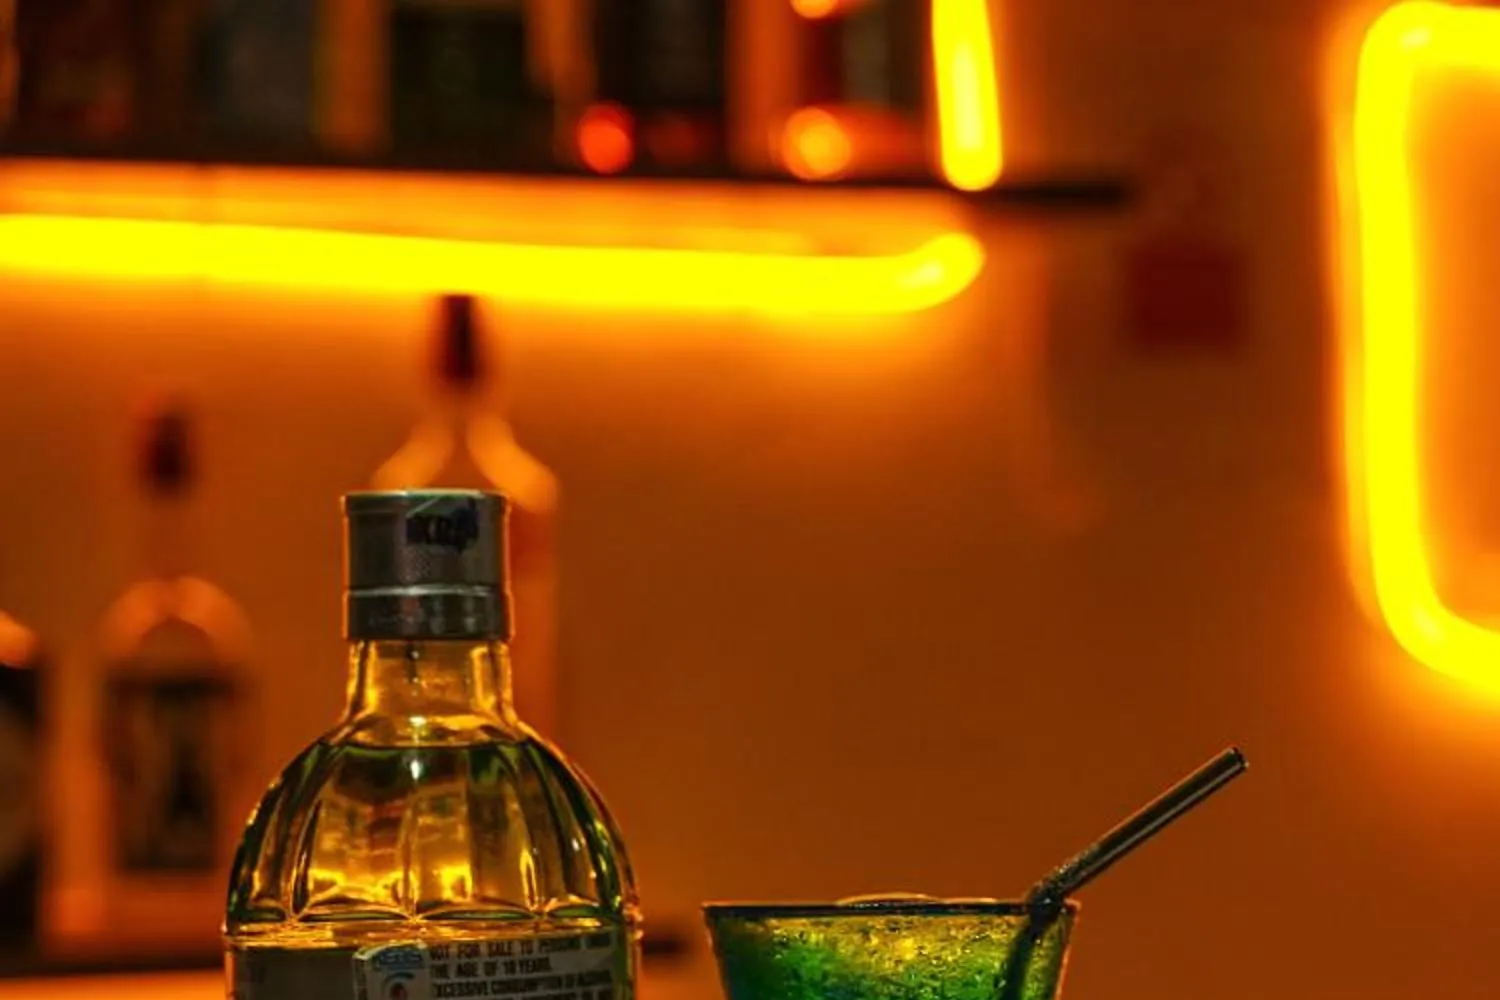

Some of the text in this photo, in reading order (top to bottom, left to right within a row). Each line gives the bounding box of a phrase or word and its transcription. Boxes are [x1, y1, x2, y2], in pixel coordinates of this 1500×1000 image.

[458, 942, 480, 957] FOR
[431, 963, 449, 978] THE
[456, 962, 478, 977] AGE
[484, 961, 496, 976] OF
